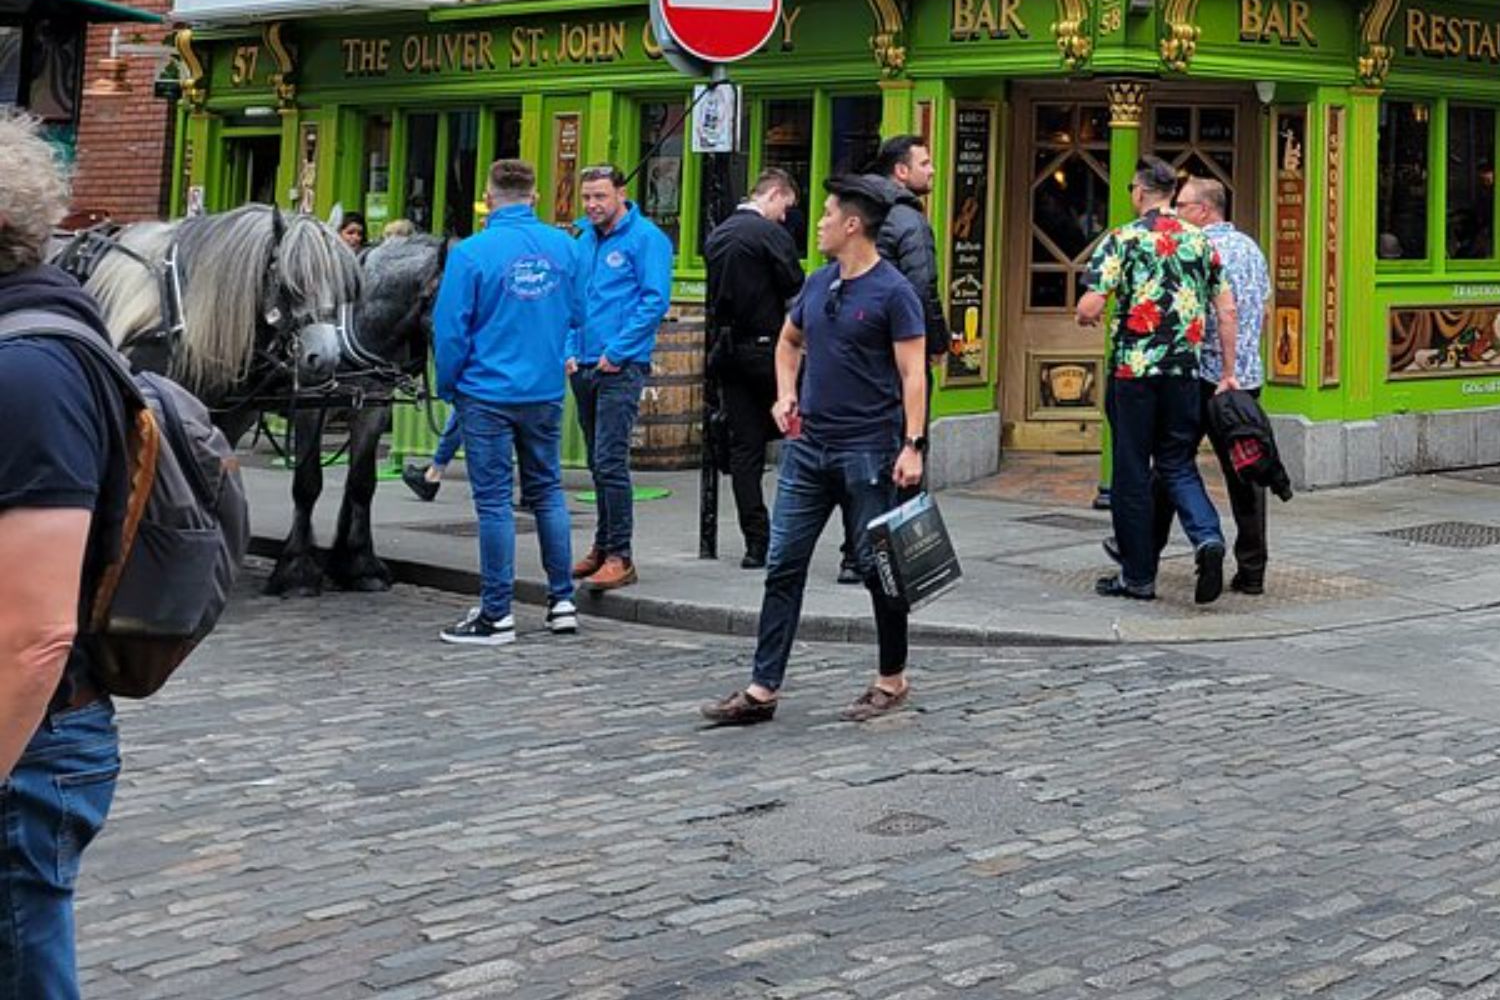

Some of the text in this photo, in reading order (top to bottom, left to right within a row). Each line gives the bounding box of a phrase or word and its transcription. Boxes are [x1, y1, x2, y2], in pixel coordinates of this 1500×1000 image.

[342, 37, 390, 75] THE
[402, 29, 494, 71] OLIVER
[557, 21, 625, 63] JOHN
[1327, 133, 1338, 252] SMOKING
